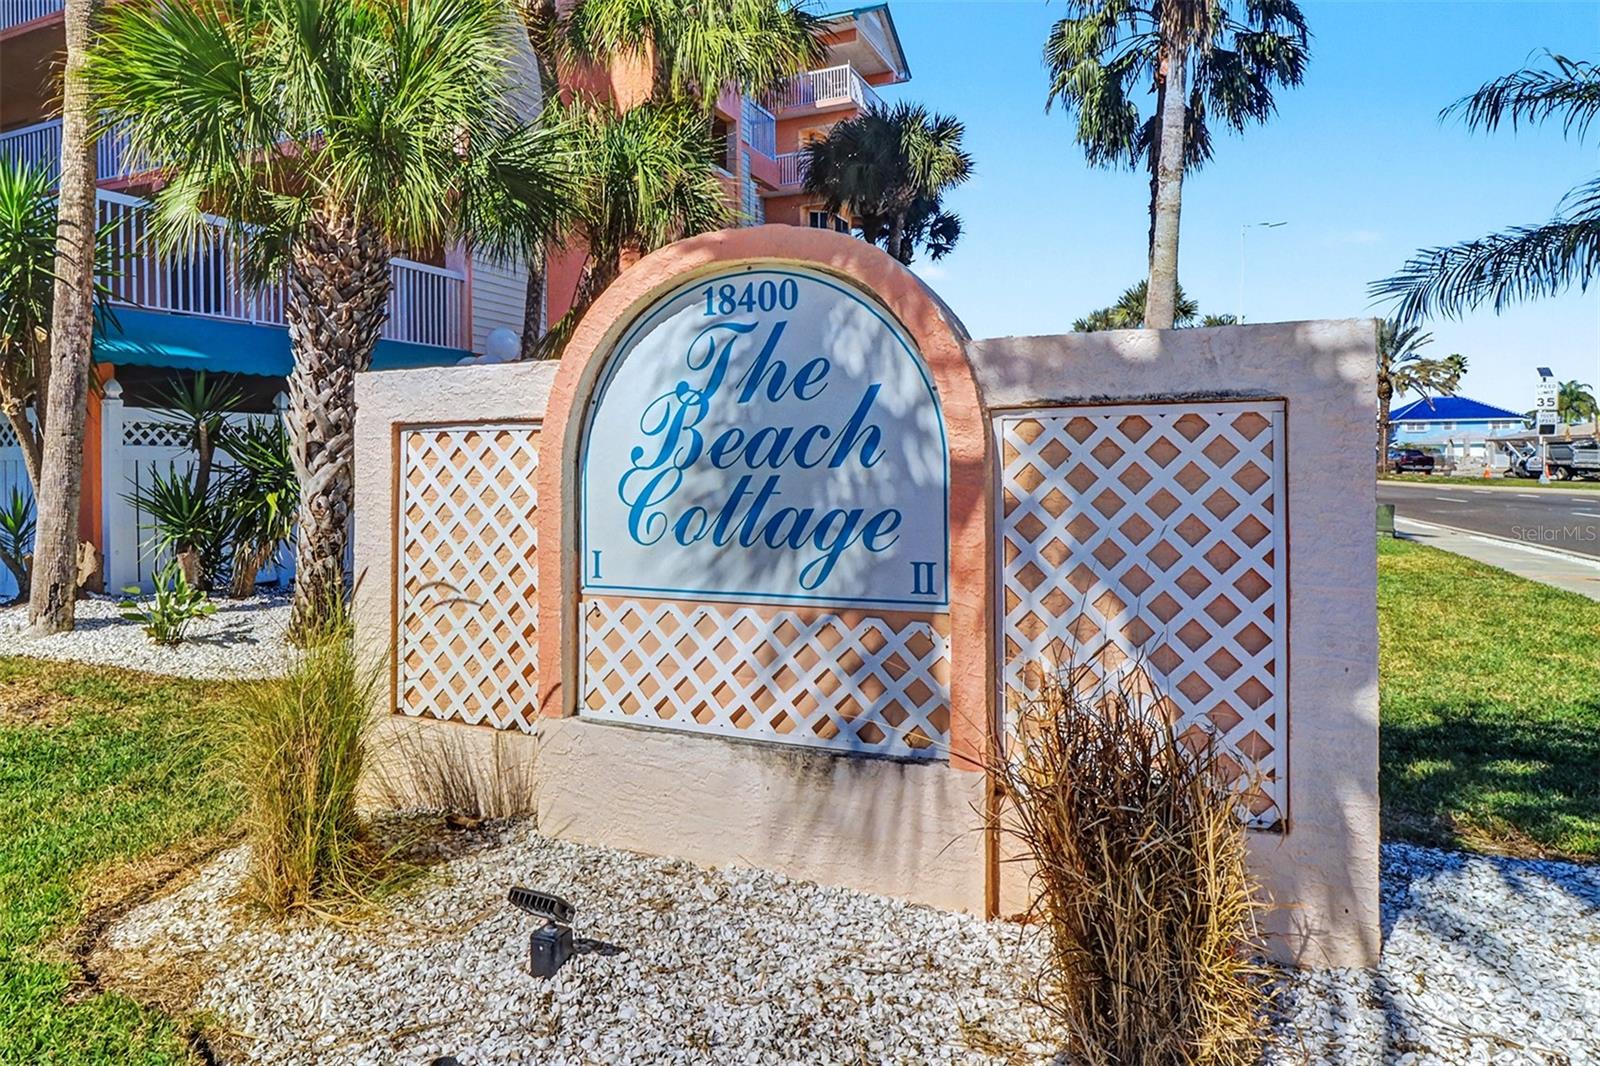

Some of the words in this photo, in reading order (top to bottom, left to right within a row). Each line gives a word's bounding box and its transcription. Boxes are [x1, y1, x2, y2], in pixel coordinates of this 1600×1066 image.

[702, 278, 798, 316] 18400
[676, 320, 831, 404] The
[1537, 397, 1555, 407] 35
[631, 383, 886, 471] Beach
[618, 464, 902, 591] Cottage
[591, 550, 603, 579] I
[910, 562, 937, 596] II
